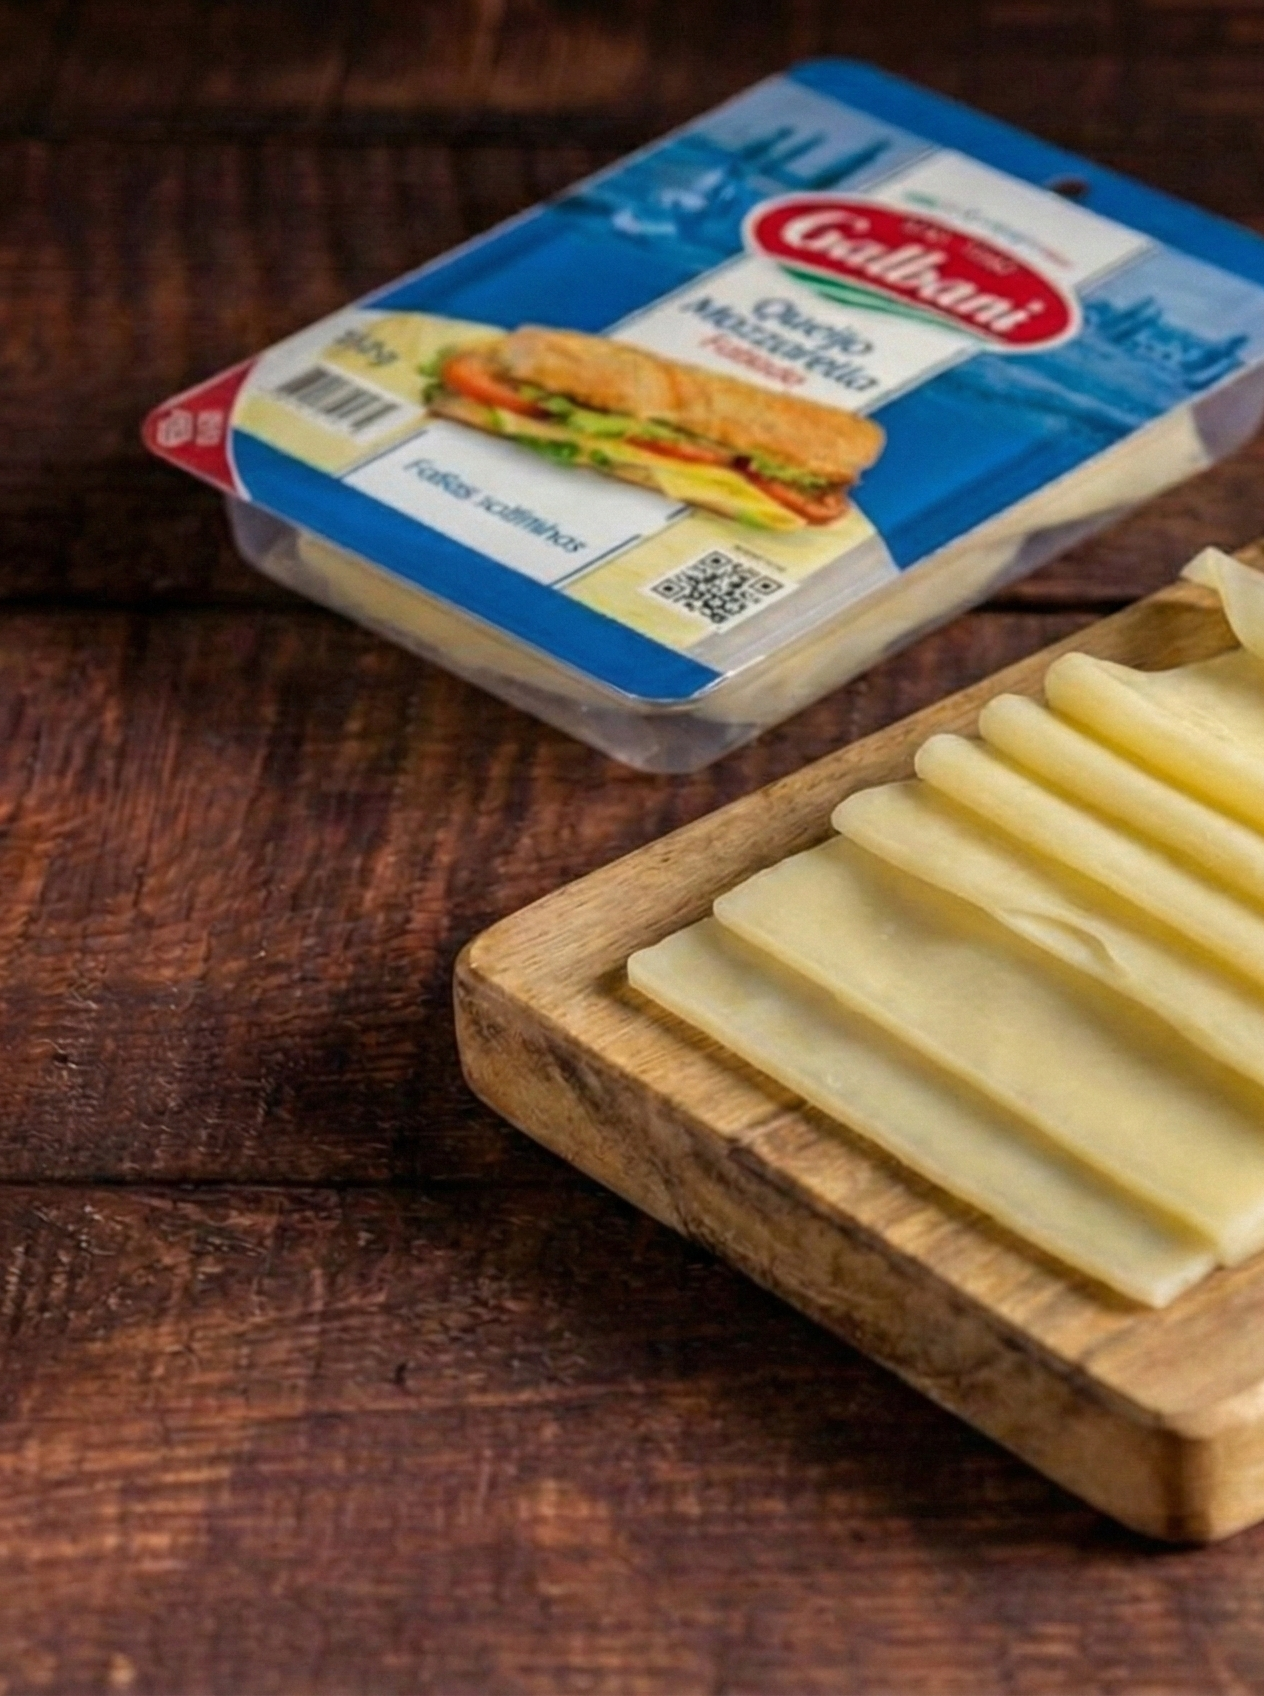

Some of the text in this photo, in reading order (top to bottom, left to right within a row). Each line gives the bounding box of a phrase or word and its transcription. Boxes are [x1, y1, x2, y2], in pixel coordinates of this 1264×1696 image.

[780, 208, 1047, 334] Galbani
[680, 297, 879, 391] Mozzarella
[752, 297, 874, 356] Queijo
